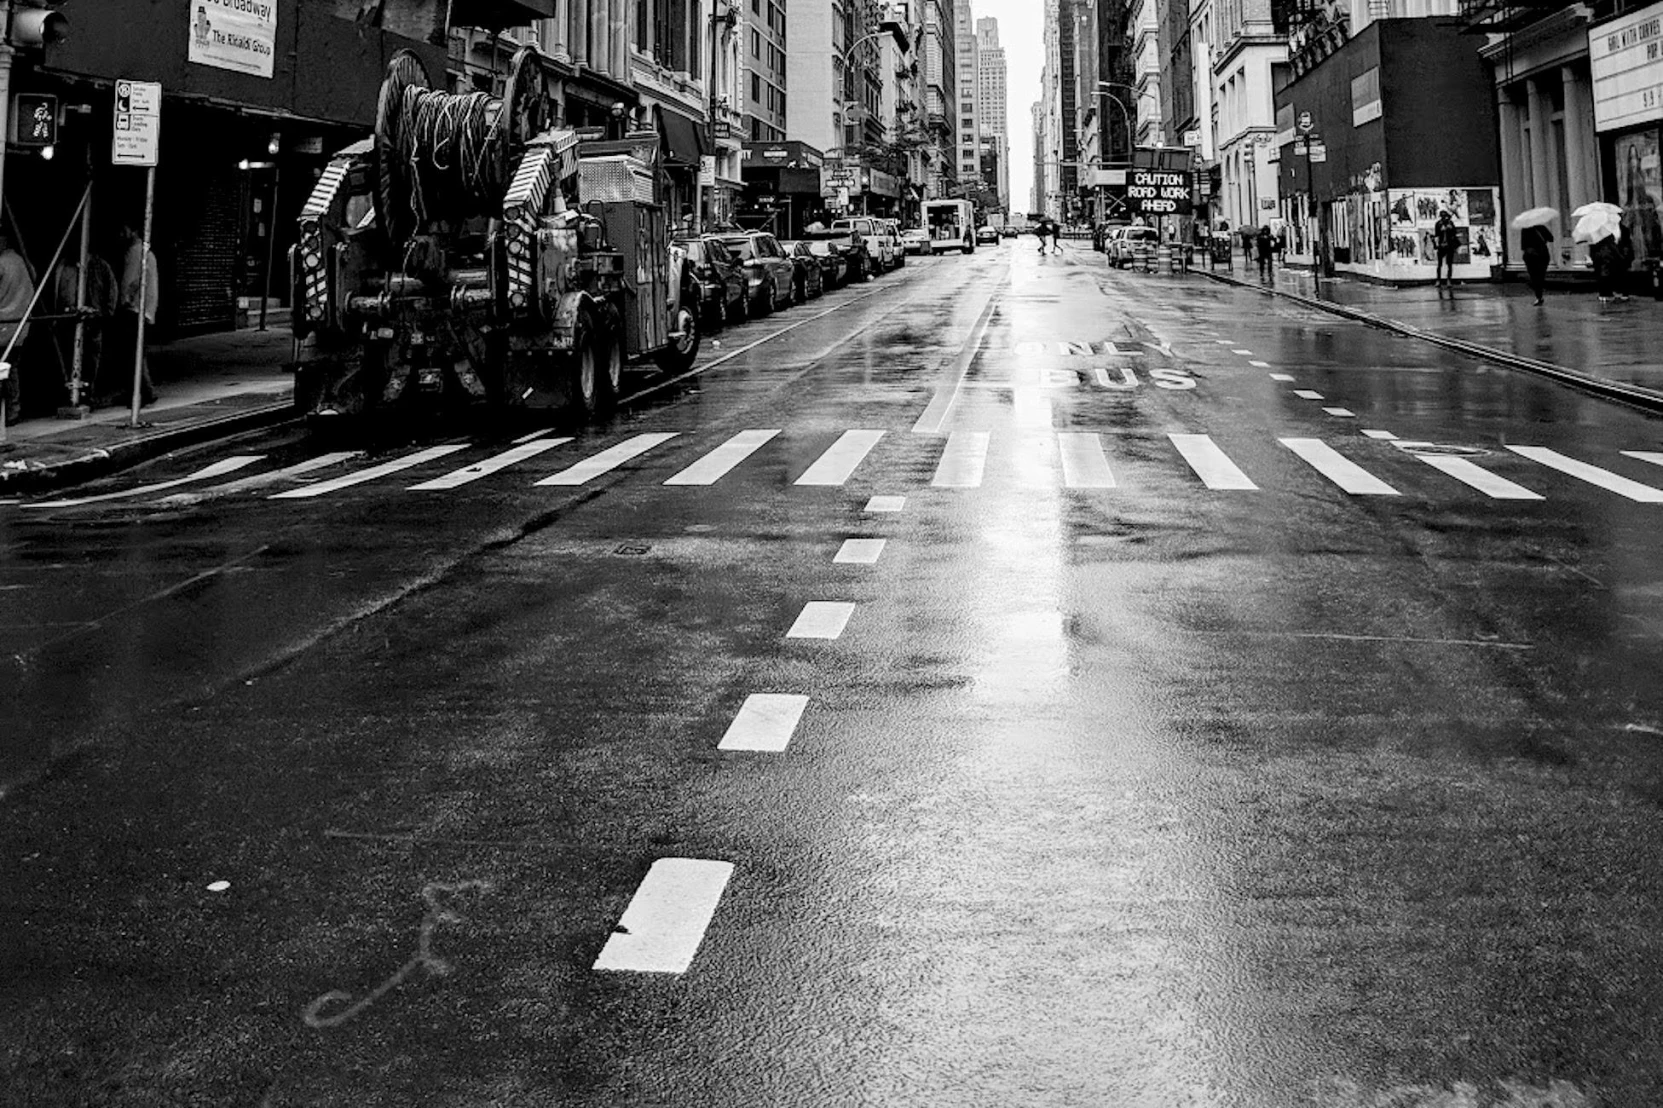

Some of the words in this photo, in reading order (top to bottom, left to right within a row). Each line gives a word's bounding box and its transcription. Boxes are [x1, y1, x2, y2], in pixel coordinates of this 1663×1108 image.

[212, 29, 226, 45] The
[1135, 173, 1183, 186] CAUTION
[1128, 185, 1157, 198] ROAD
[1161, 187, 1190, 199] WORK
[1141, 199, 1177, 212] AHEAD
[1014, 341, 1172, 358] ONLY
[1040, 367, 1198, 390] BUS
